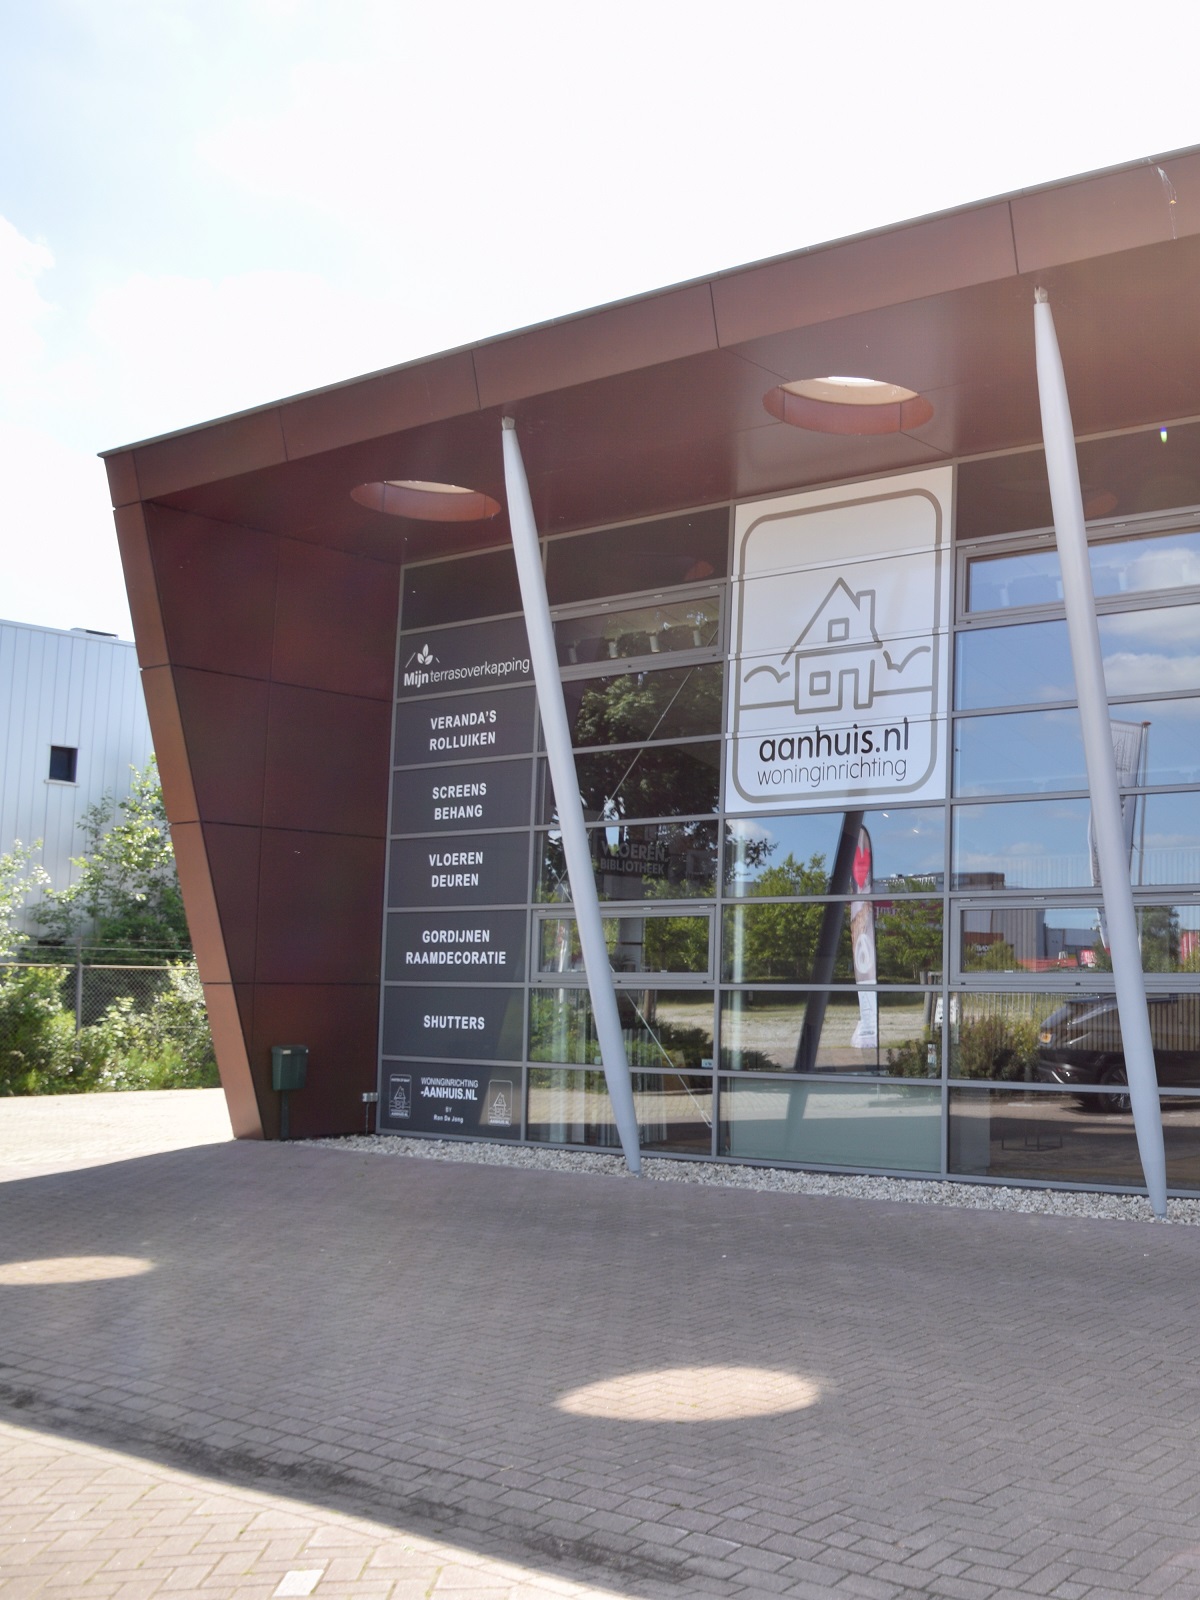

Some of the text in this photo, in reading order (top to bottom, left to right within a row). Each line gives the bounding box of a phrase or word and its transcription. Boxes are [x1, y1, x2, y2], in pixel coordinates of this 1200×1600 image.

[430, 709, 497, 730] VERANDA'S
[429, 731, 496, 751] ROLLUIKEN
[759, 716, 909, 762] aanhuis.nl
[757, 756, 907, 788] woninginrichting
[432, 782, 487, 800] SCREENS
[434, 804, 483, 820] BEHANG
[428, 851, 484, 867] VLOEREN
[600, 858, 665, 875] BIBLIOTHEEK
[431, 873, 479, 888] DEUREN
[422, 930, 490, 943] GORDIJNEN
[405, 951, 506, 965] RAAMDECORATIE
[423, 1015, 485, 1030] SHUTTERS
[421, 1077, 478, 1088] WONINGINRICHTING
